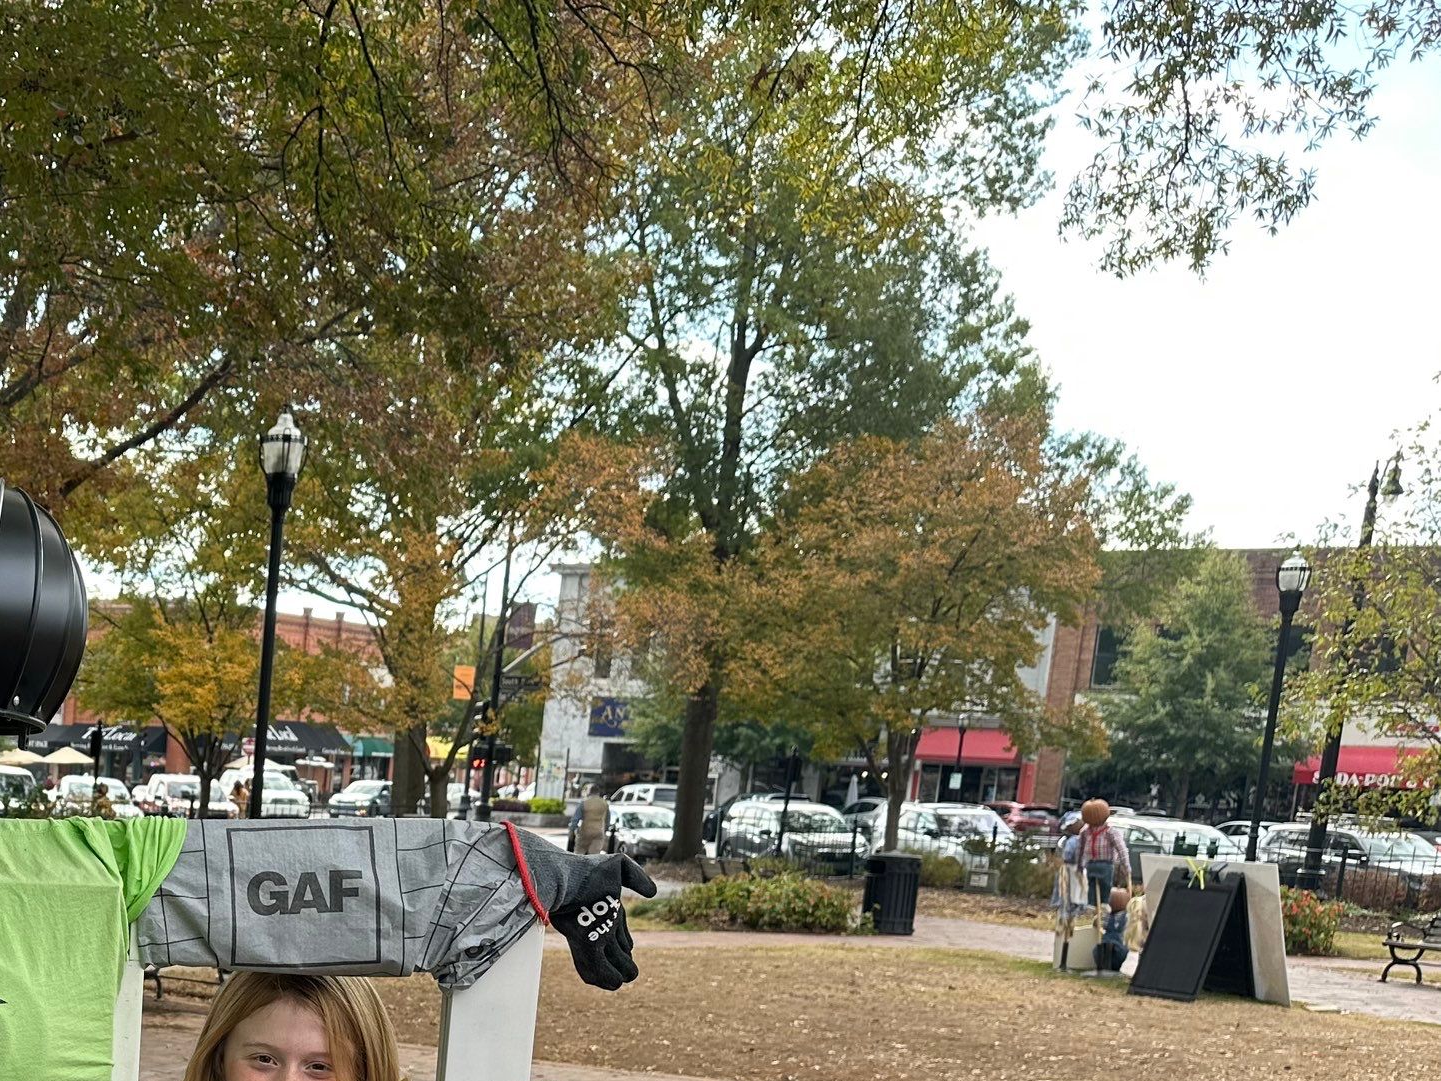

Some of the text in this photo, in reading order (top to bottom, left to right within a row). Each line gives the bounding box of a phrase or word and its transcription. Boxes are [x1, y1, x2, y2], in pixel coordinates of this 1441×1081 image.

[246, 870, 363, 916] GAF
[577, 895, 620, 926] top
[588, 918, 614, 941] the
